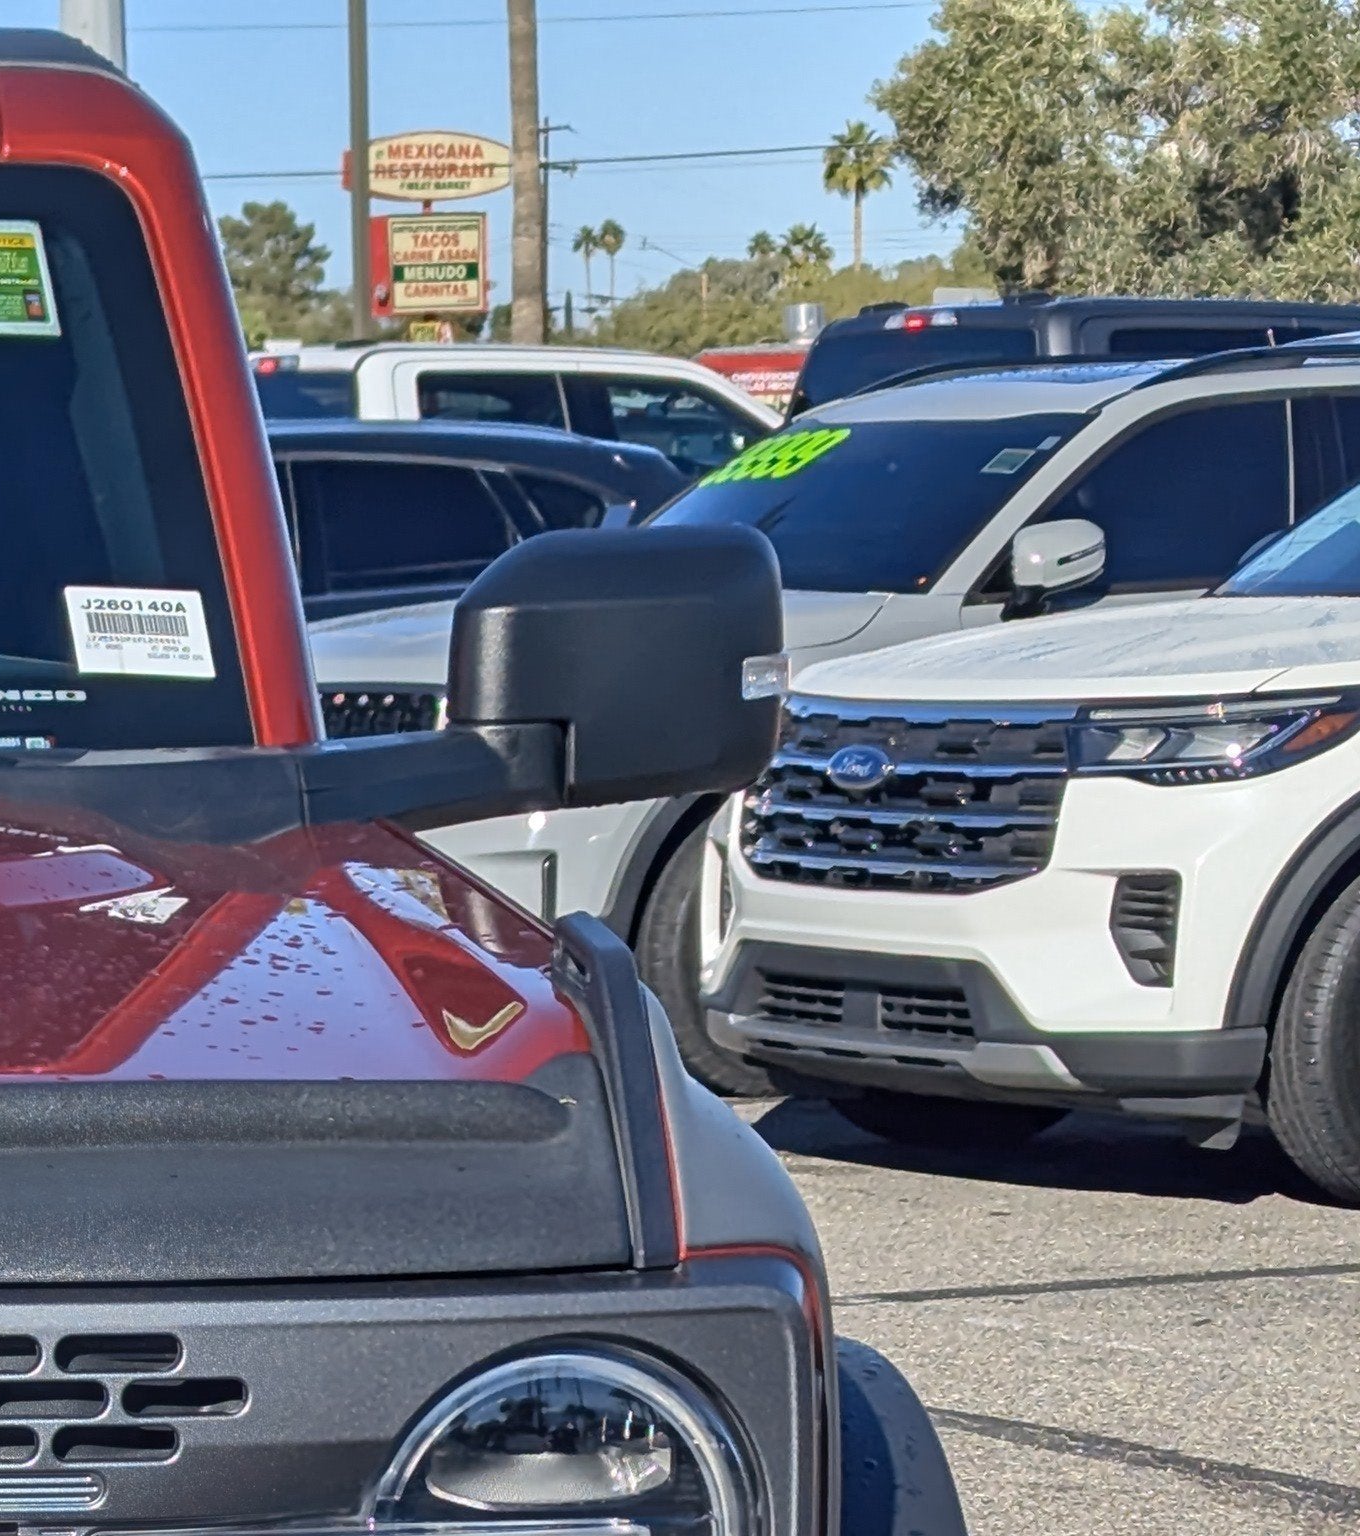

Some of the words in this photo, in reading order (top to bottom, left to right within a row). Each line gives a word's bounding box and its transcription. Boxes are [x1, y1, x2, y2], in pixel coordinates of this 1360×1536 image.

[387, 143, 484, 159] MEXICANA
[374, 162, 496, 179] RESTAURANT
[412, 233, 460, 247] TACOS
[394, 251, 433, 263] CARNE
[438, 249, 478, 261] ASADA
[403, 265, 468, 280] MENUDO
[404, 284, 468, 298] CARNITAS
[81, 598, 187, 614] J260140A
